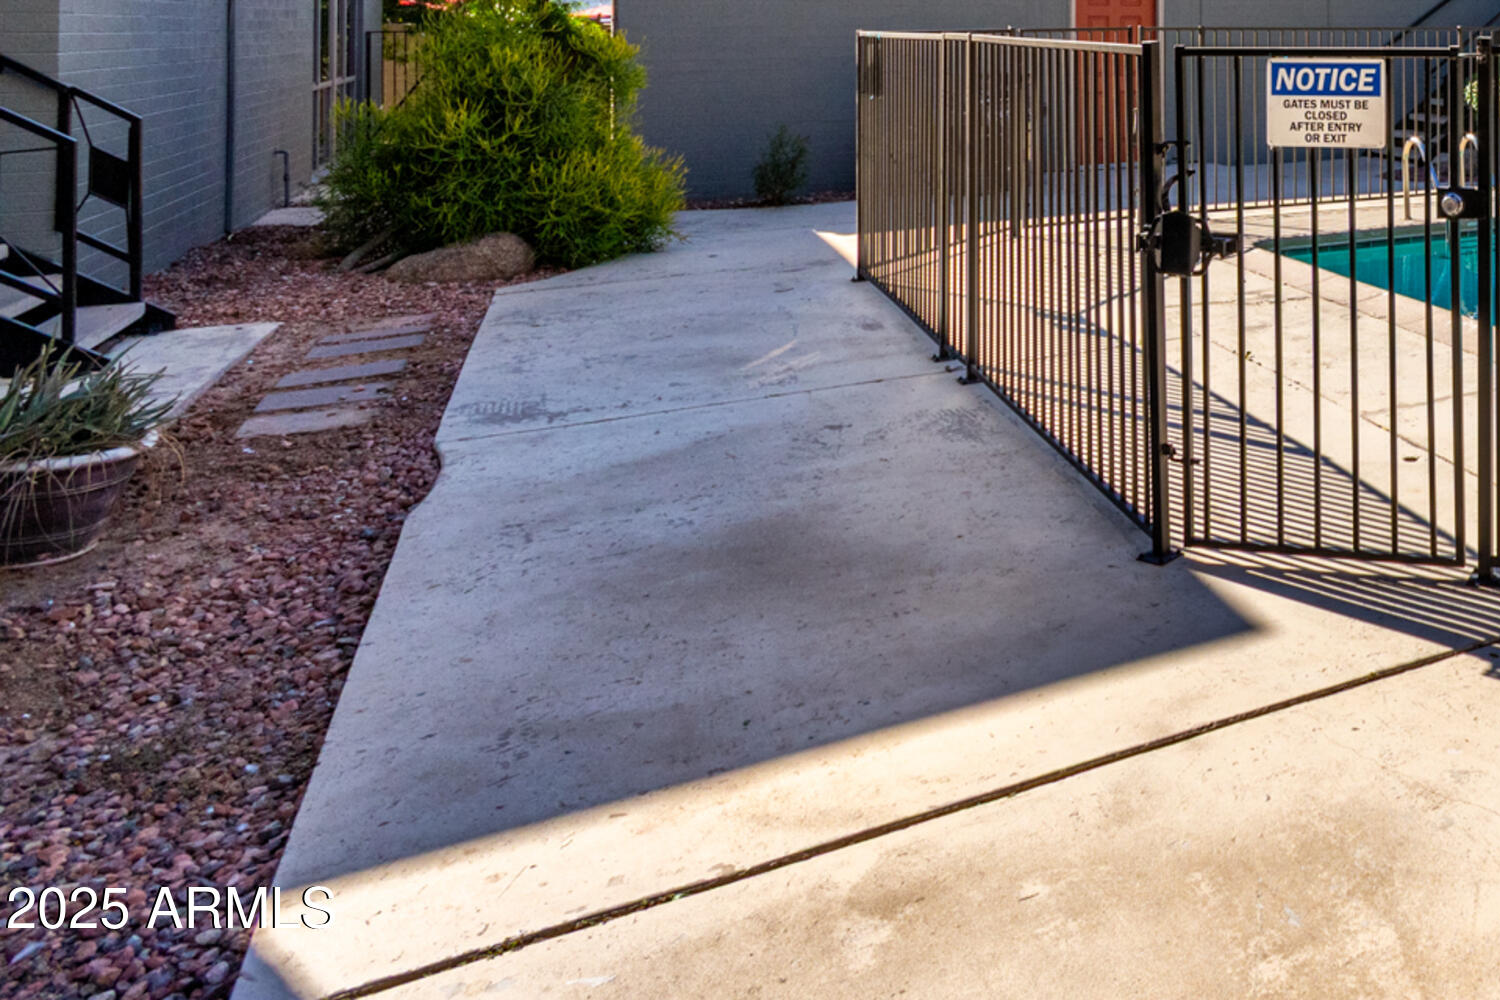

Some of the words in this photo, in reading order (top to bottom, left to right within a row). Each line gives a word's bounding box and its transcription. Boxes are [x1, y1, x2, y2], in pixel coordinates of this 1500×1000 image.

[1275, 67, 1377, 92] NOTICE
[1283, 99, 1317, 109] GATES
[1320, 100, 1351, 109] MUST
[1354, 100, 1369, 110] BE
[1304, 111, 1348, 121] CLOSED
[1290, 122, 1324, 132] AFTER
[1328, 122, 1362, 132] ENTRY
[1304, 133, 1320, 143] OR
[1323, 133, 1347, 143] EXIT
